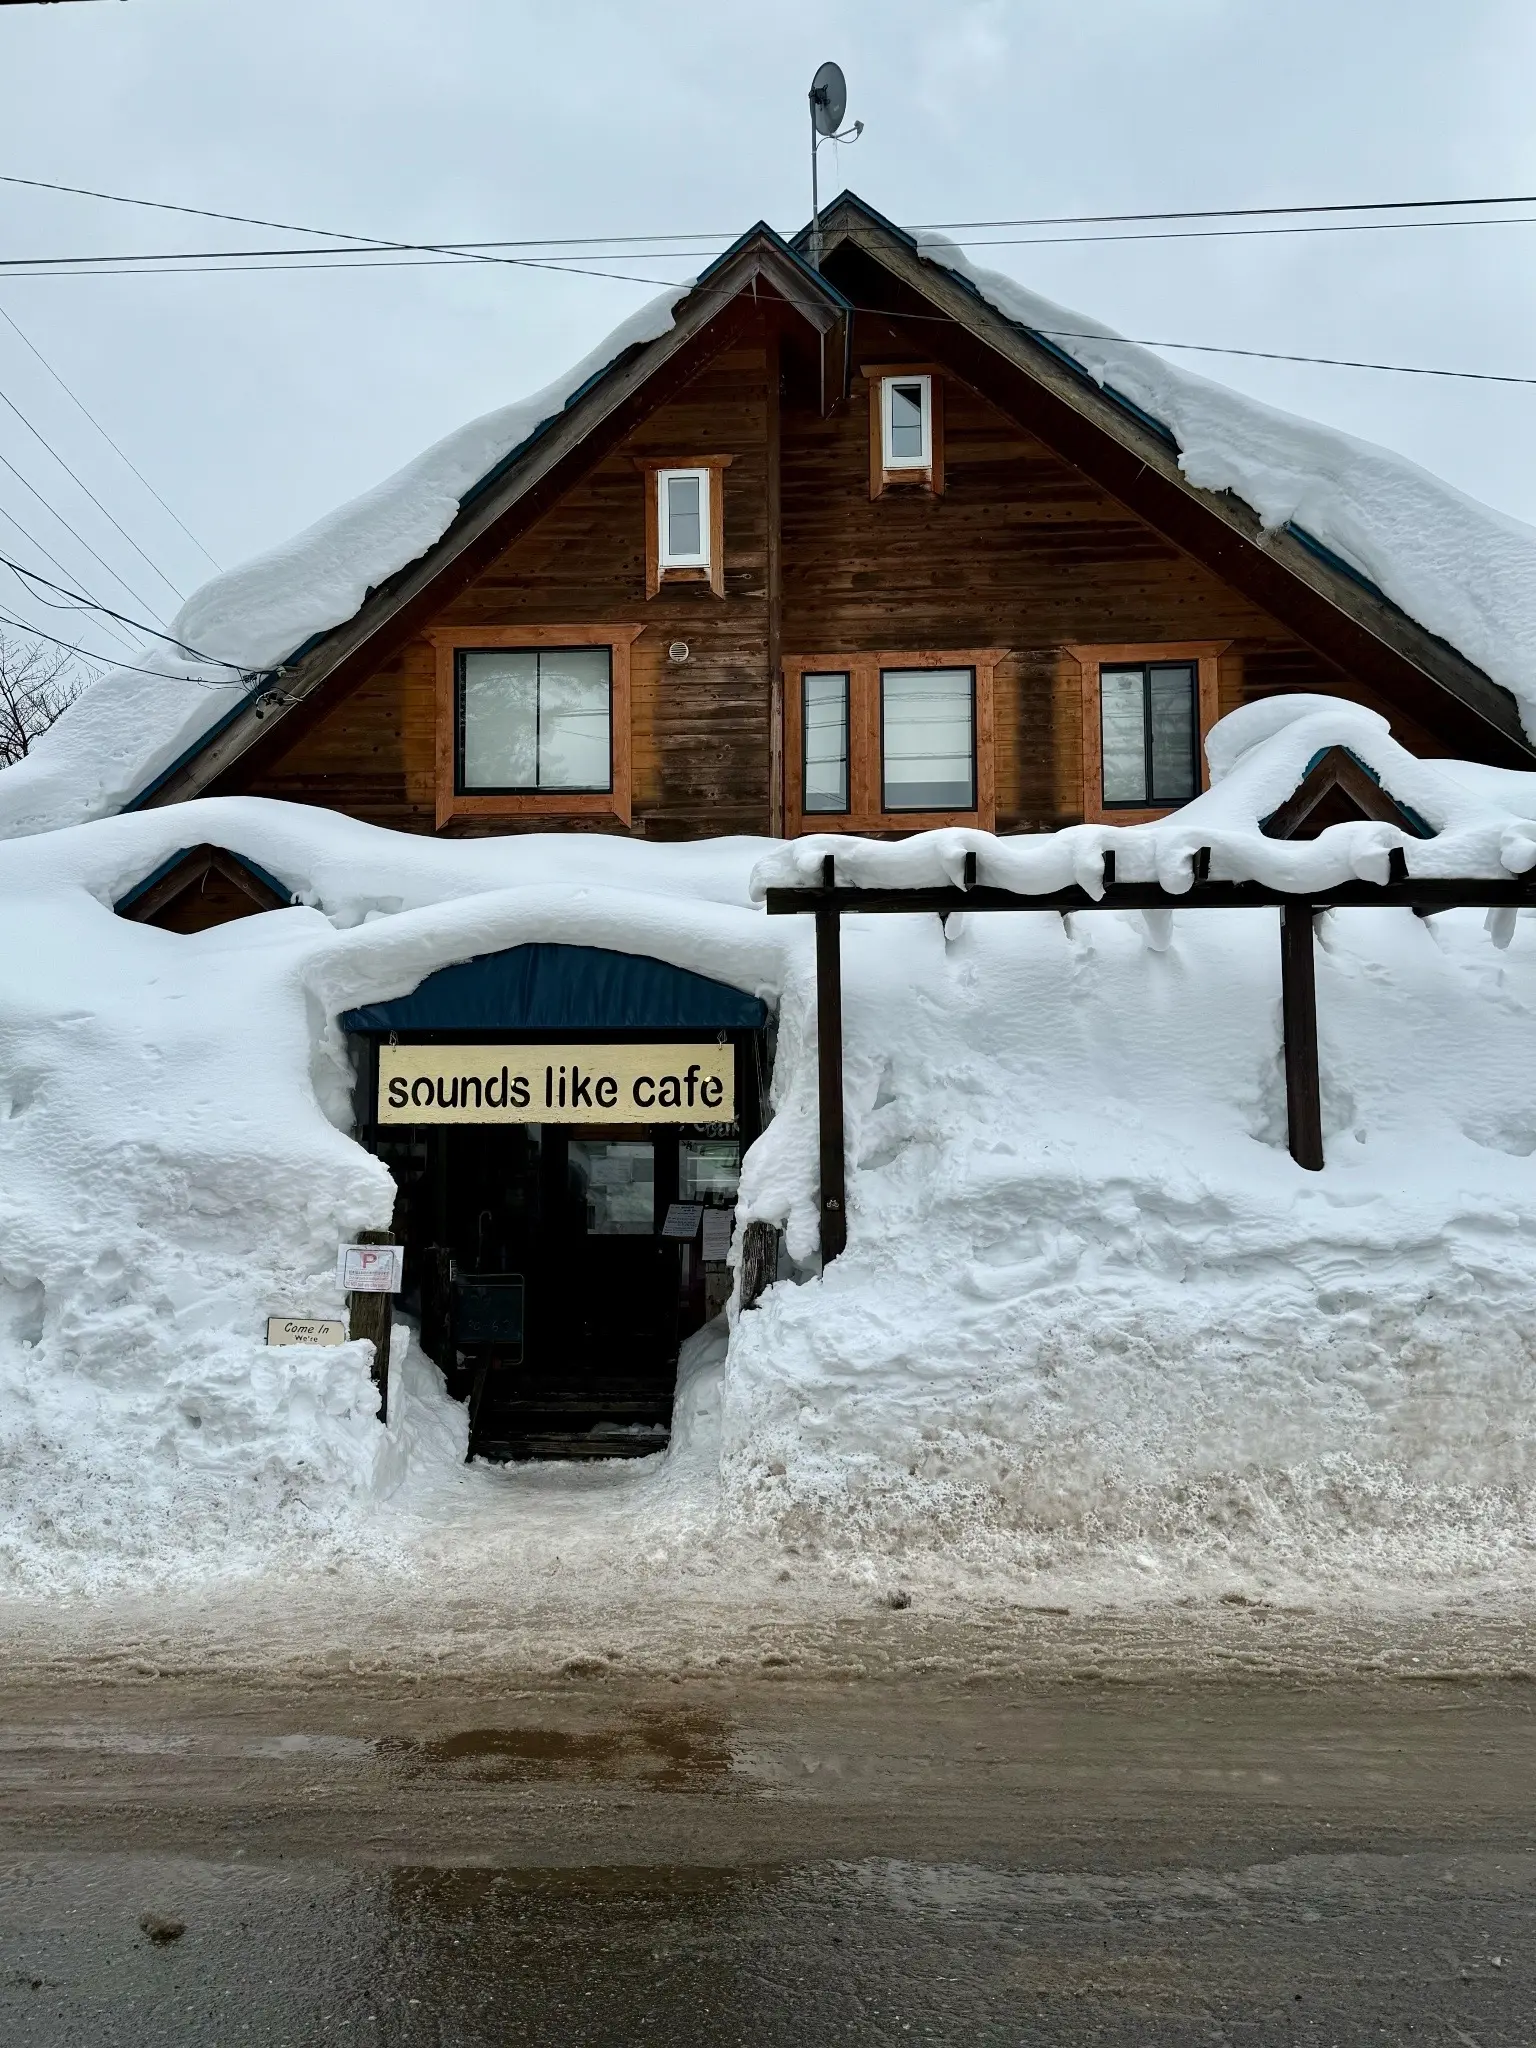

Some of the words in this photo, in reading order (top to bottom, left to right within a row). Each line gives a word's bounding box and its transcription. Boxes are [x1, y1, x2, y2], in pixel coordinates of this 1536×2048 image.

[388, 1065, 531, 1109] sounds
[545, 1065, 618, 1109] like
[632, 1064, 724, 1109] cafe
[361, 1252, 377, 1268] P
[284, 1322, 315, 1334] Come
[318, 1324, 330, 1334] In
[294, 1335, 319, 1343] We're
